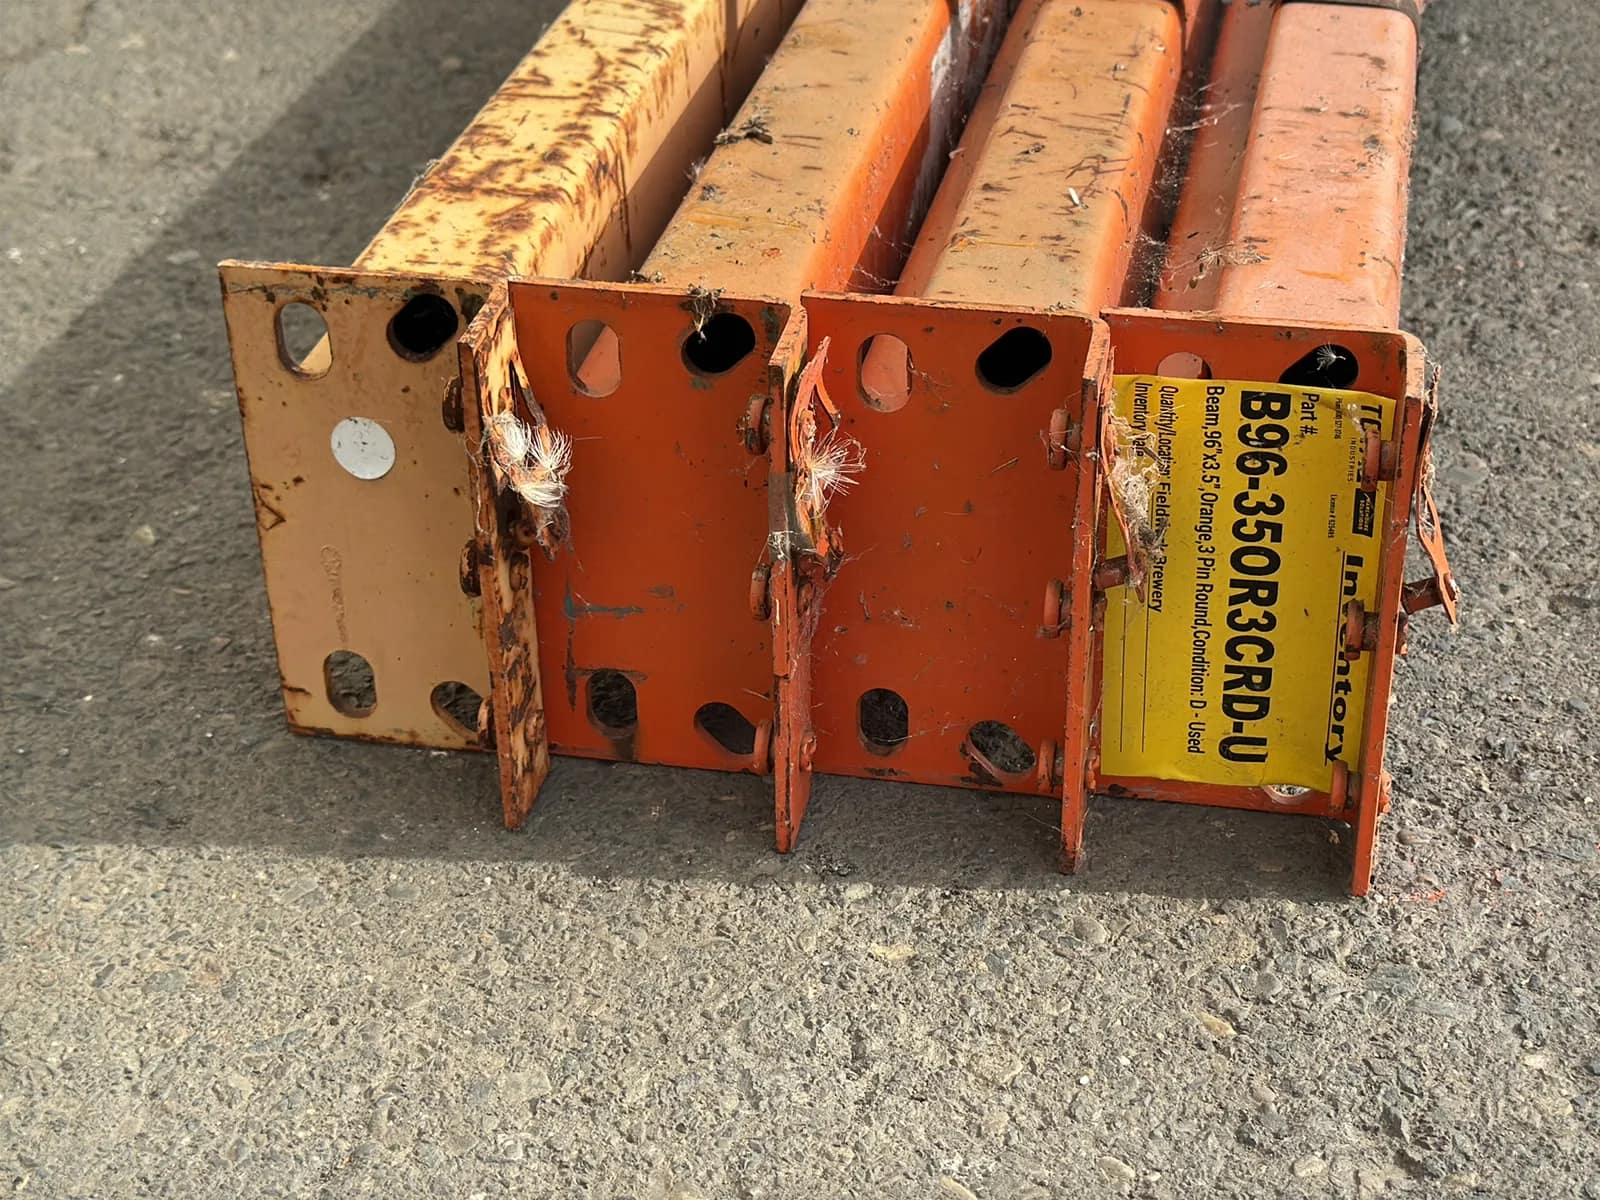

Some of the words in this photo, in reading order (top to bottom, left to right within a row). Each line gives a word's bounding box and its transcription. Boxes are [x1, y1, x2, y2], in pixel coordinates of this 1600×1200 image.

[1130, 382, 1153, 431] Inventory
[1301, 392, 1320, 421] Part
[1301, 425, 1318, 435] #
[1194, 386, 1226, 553] Beam,96"x3.5",Orange,3
[1347, 437, 1356, 482] INDUSTRIES
[1147, 555, 1167, 613] Brewery
[1195, 556, 1215, 580] Pin
[1190, 583, 1214, 696] Round,Condition:
[1190, 700, 1206, 710] D
[1187, 722, 1206, 753] Used
